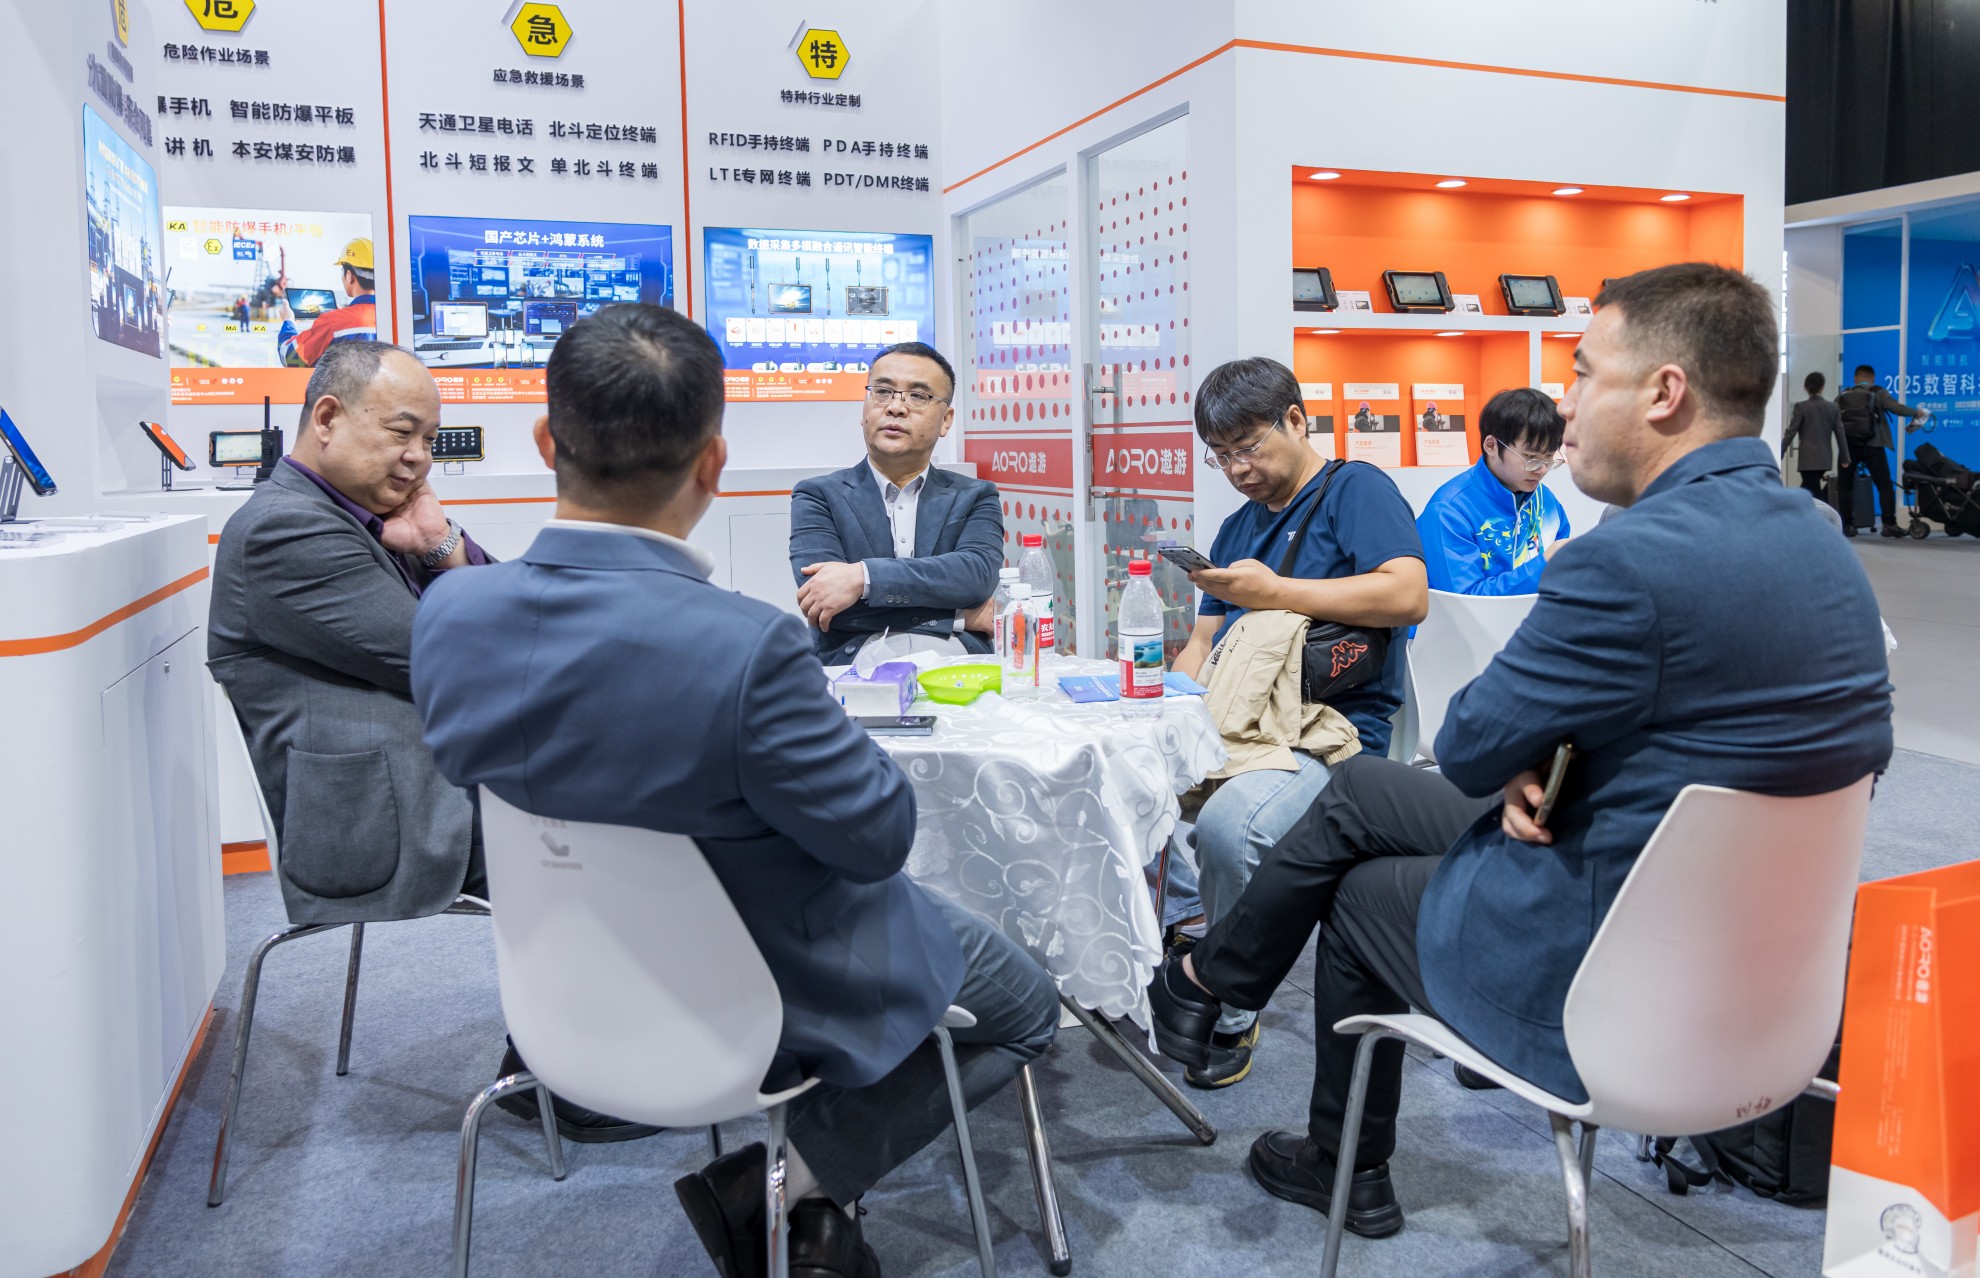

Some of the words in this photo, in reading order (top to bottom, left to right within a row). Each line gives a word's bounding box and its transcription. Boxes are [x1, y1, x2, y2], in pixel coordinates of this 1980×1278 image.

[527, 15, 558, 46] 急
[164, 43, 270, 65] 危险作业场景
[810, 40, 838, 69] 特
[493, 68, 585, 88] 应急救援场景
[780, 89, 861, 108] 特种行业定制
[230, 99, 354, 124] 智能防爆平板
[419, 112, 533, 136] 天通卫星电话
[549, 121, 657, 143] 北斗定位终端
[232, 141, 355, 163] 本安煤安防爆
[709, 132, 810, 152] RFID手持终端
[823, 139, 929, 159] PDA手持终端
[420, 151, 534, 173] 北斗短报文
[550, 158, 658, 178] 单北斗终端
[709, 167, 811, 187] LTE专网终端
[823, 173, 929, 192] PDT/DMR终端
[484, 230, 605, 248] 国产芯片+鸿蒙系统
[1884, 373, 1980, 395] 2025数智科
